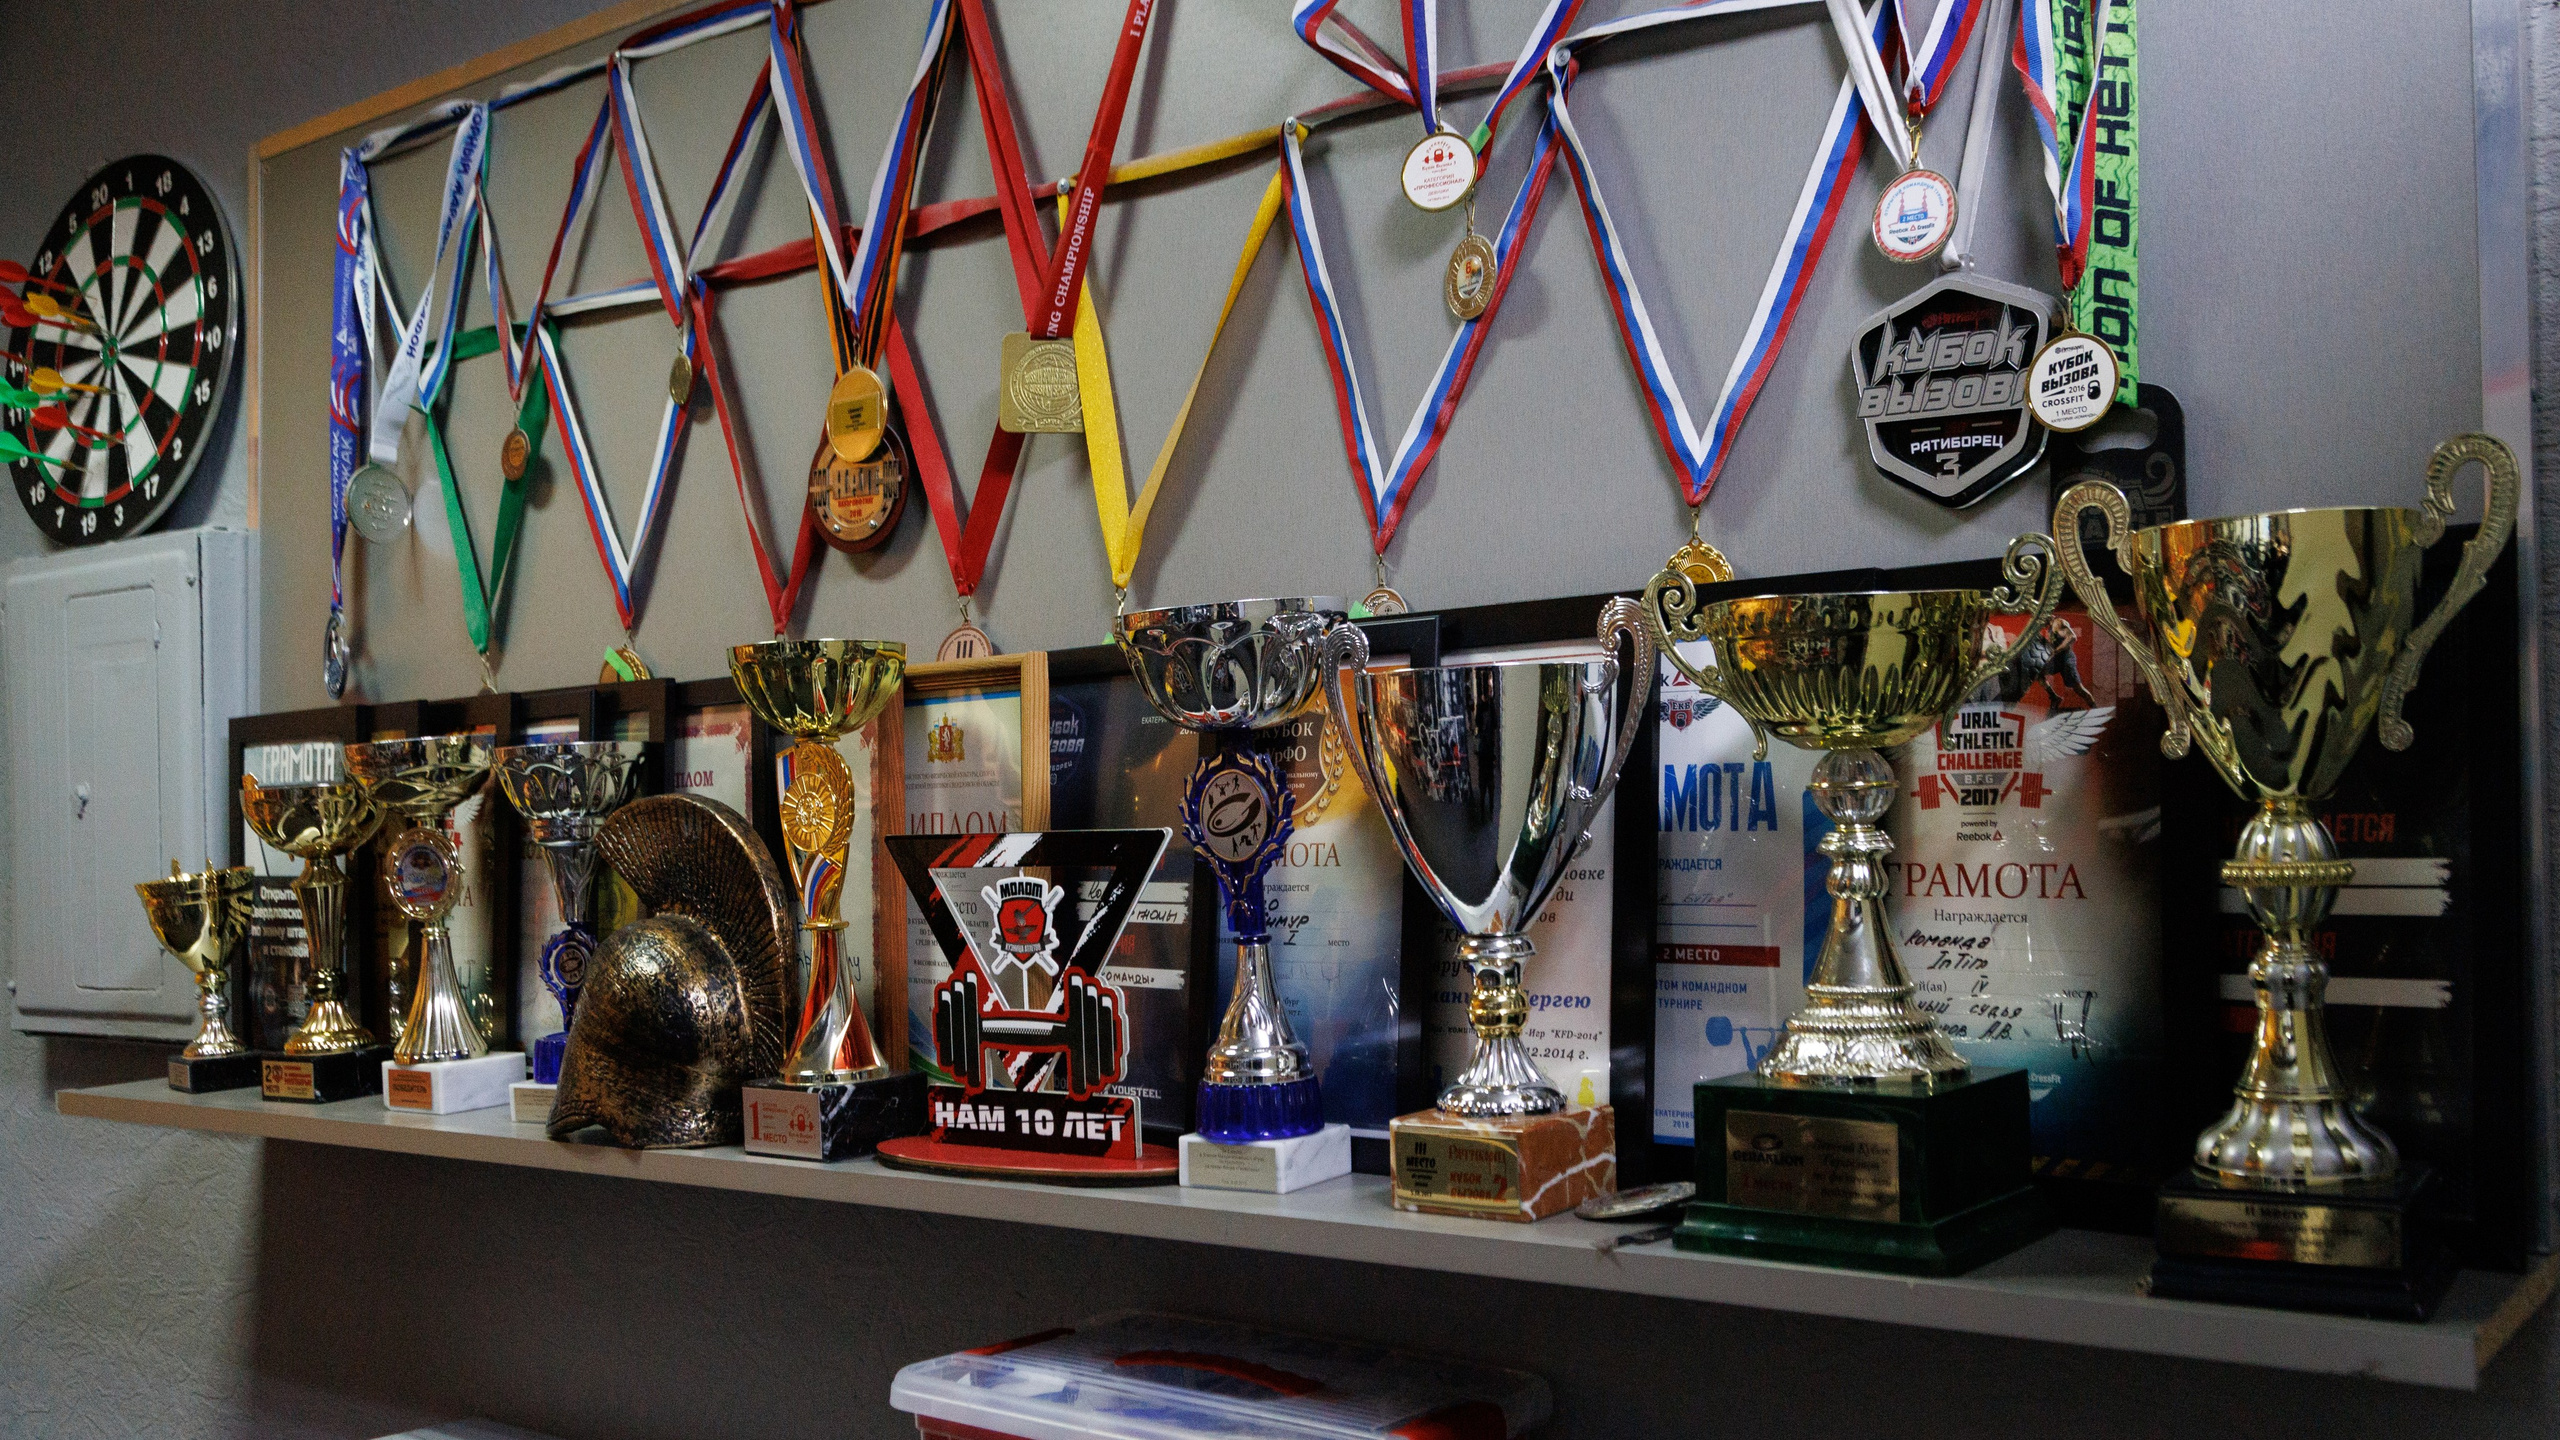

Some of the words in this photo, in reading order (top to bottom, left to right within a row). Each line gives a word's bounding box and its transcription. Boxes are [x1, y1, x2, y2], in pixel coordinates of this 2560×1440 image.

[125, 170, 134, 192] 1
[1424, 174, 1455, 183] КАТЕГОРИЯ
[91, 182, 109, 211] 20
[180, 194, 190, 217] 4
[68, 212, 78, 235] 5
[1907, 213, 1925, 221] МЕСТО
[2095, 178, 2130, 249] OF
[196, 229, 214, 257] 13
[1055, 186, 1096, 307] CHAMPIONSHIP
[1465, 261, 1472, 274] 6
[207, 275, 218, 300] 6
[205, 325, 222, 353] 10
[1872, 303, 2032, 386] КУБОК
[2048, 350, 2093, 376] КУБОК
[2041, 363, 2099, 393] ВЫЗОВА
[2069, 385, 2085, 394] 2016
[194, 378, 211, 407] 15
[2042, 395, 2084, 408] CROSSFIT
[2061, 406, 2087, 416] МЕСТО
[172, 437, 183, 462] 2
[1910, 435, 2004, 454] РАТИБОРЕЦ
[1936, 452, 1961, 479] 3
[29, 480, 46, 507] 16
[143, 473, 160, 501] 17
[55, 506, 66, 529] 7
[81, 511, 97, 537] 19
[114, 504, 124, 528] 3
[1961, 711, 2001, 730] URAL
[262, 743, 335, 783] ГРАМОТА
[1937, 751, 2023, 770] CHALLENGE
[1659, 762, 1778, 832] МОТА
[1960, 788, 1999, 806] 2017
[1961, 820, 1988, 828] powered
[1990, 819, 1998, 828] by
[1957, 832, 1991, 842] Reebok
[1933, 909, 2028, 925] Награждается
[1664, 949, 1670, 958] 2
[1675, 949, 1720, 961] МЕСТО
[1682, 981, 1747, 994] КОМАНДНОМ
[1659, 999, 1703, 1010] ТУРНИРЕ
[265, 1065, 272, 1083] 2
[1112, 1085, 1162, 1099] YOUSTEEL
[749, 1100, 762, 1140] 1
[934, 1101, 1006, 1132] НАМ
[1015, 1108, 1055, 1136] 10
[1062, 1111, 1126, 1142] ЛЕТ
[763, 1133, 788, 1144] МЕСТО
[1406, 1156, 1436, 1169] МЕСТО
[1493, 1174, 1508, 1203] 2
